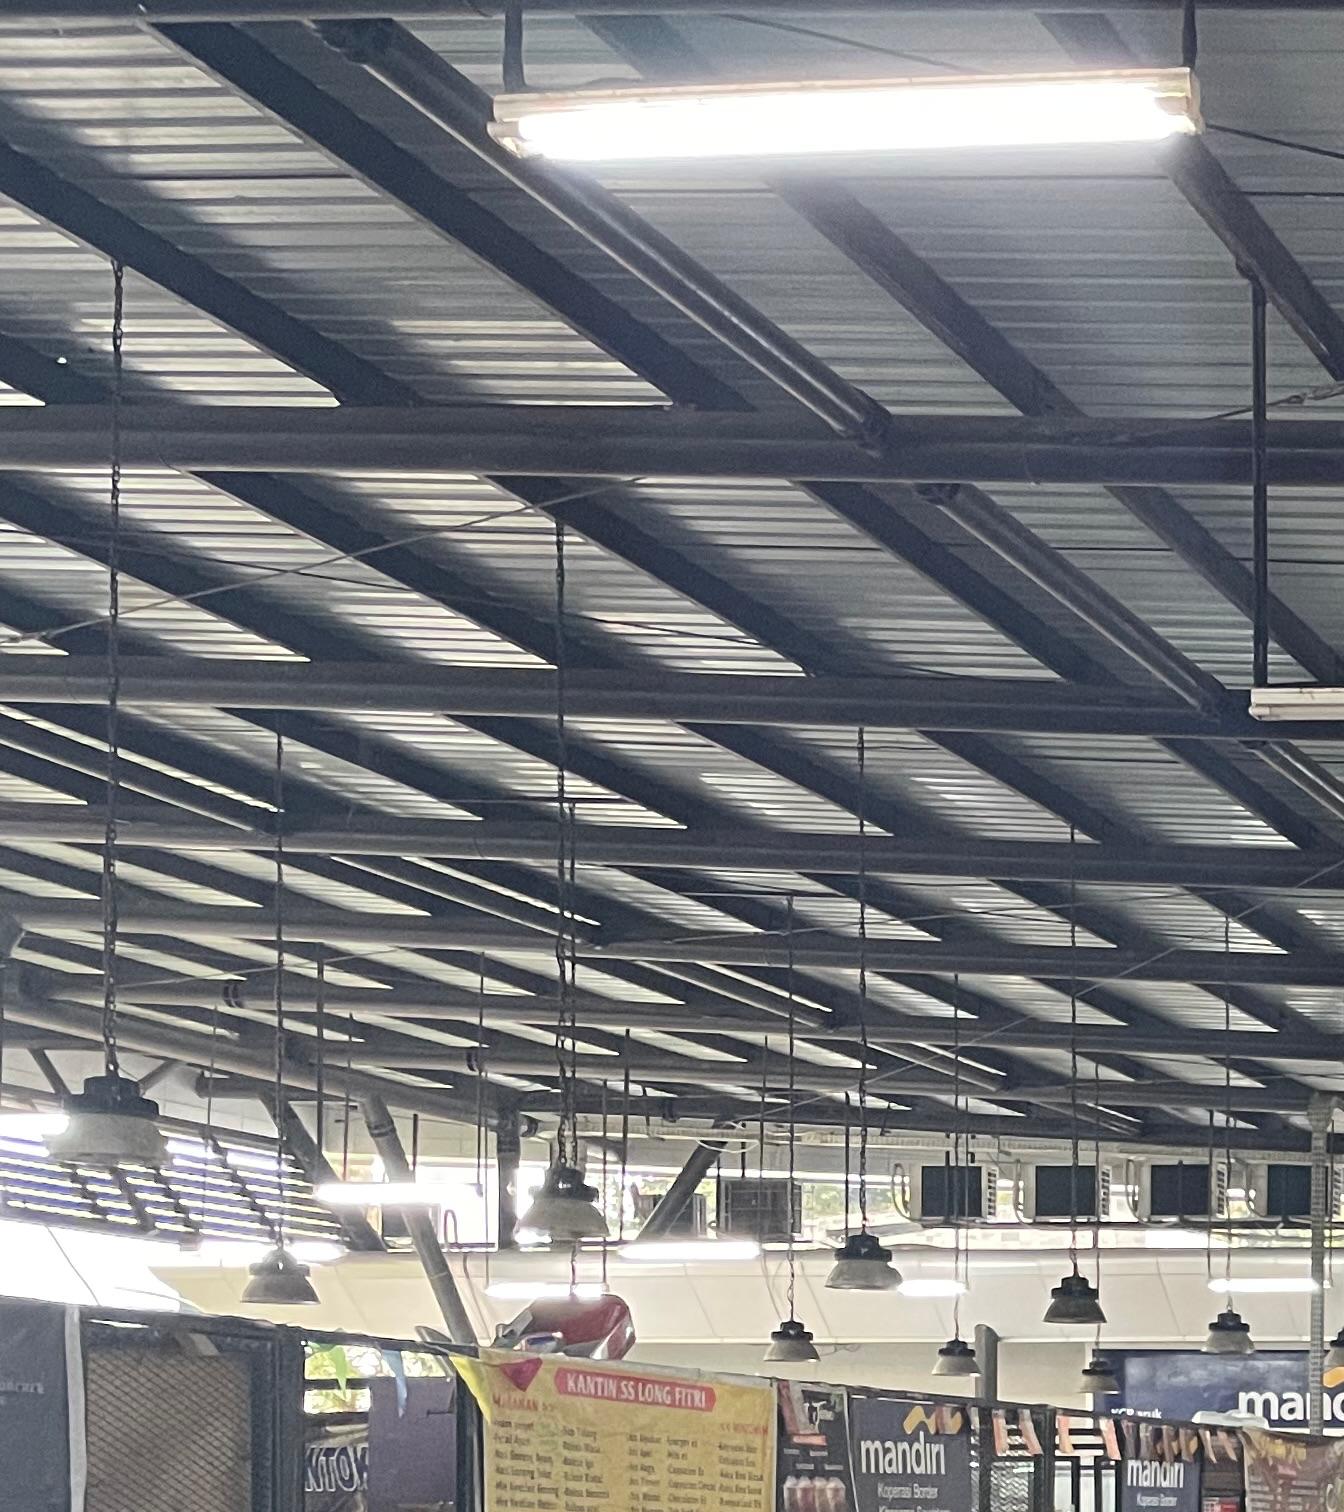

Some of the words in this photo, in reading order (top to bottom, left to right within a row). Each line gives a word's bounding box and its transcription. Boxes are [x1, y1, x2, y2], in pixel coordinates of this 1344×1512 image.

[566, 1373, 615, 1398] KANTIN
[620, 1381, 634, 1400] SS
[638, 1383, 671, 1404] LONG
[675, 1387, 706, 1408] FITRI
[861, 1431, 946, 1475] mandiri
[1127, 1459, 1184, 1489] mandiri
